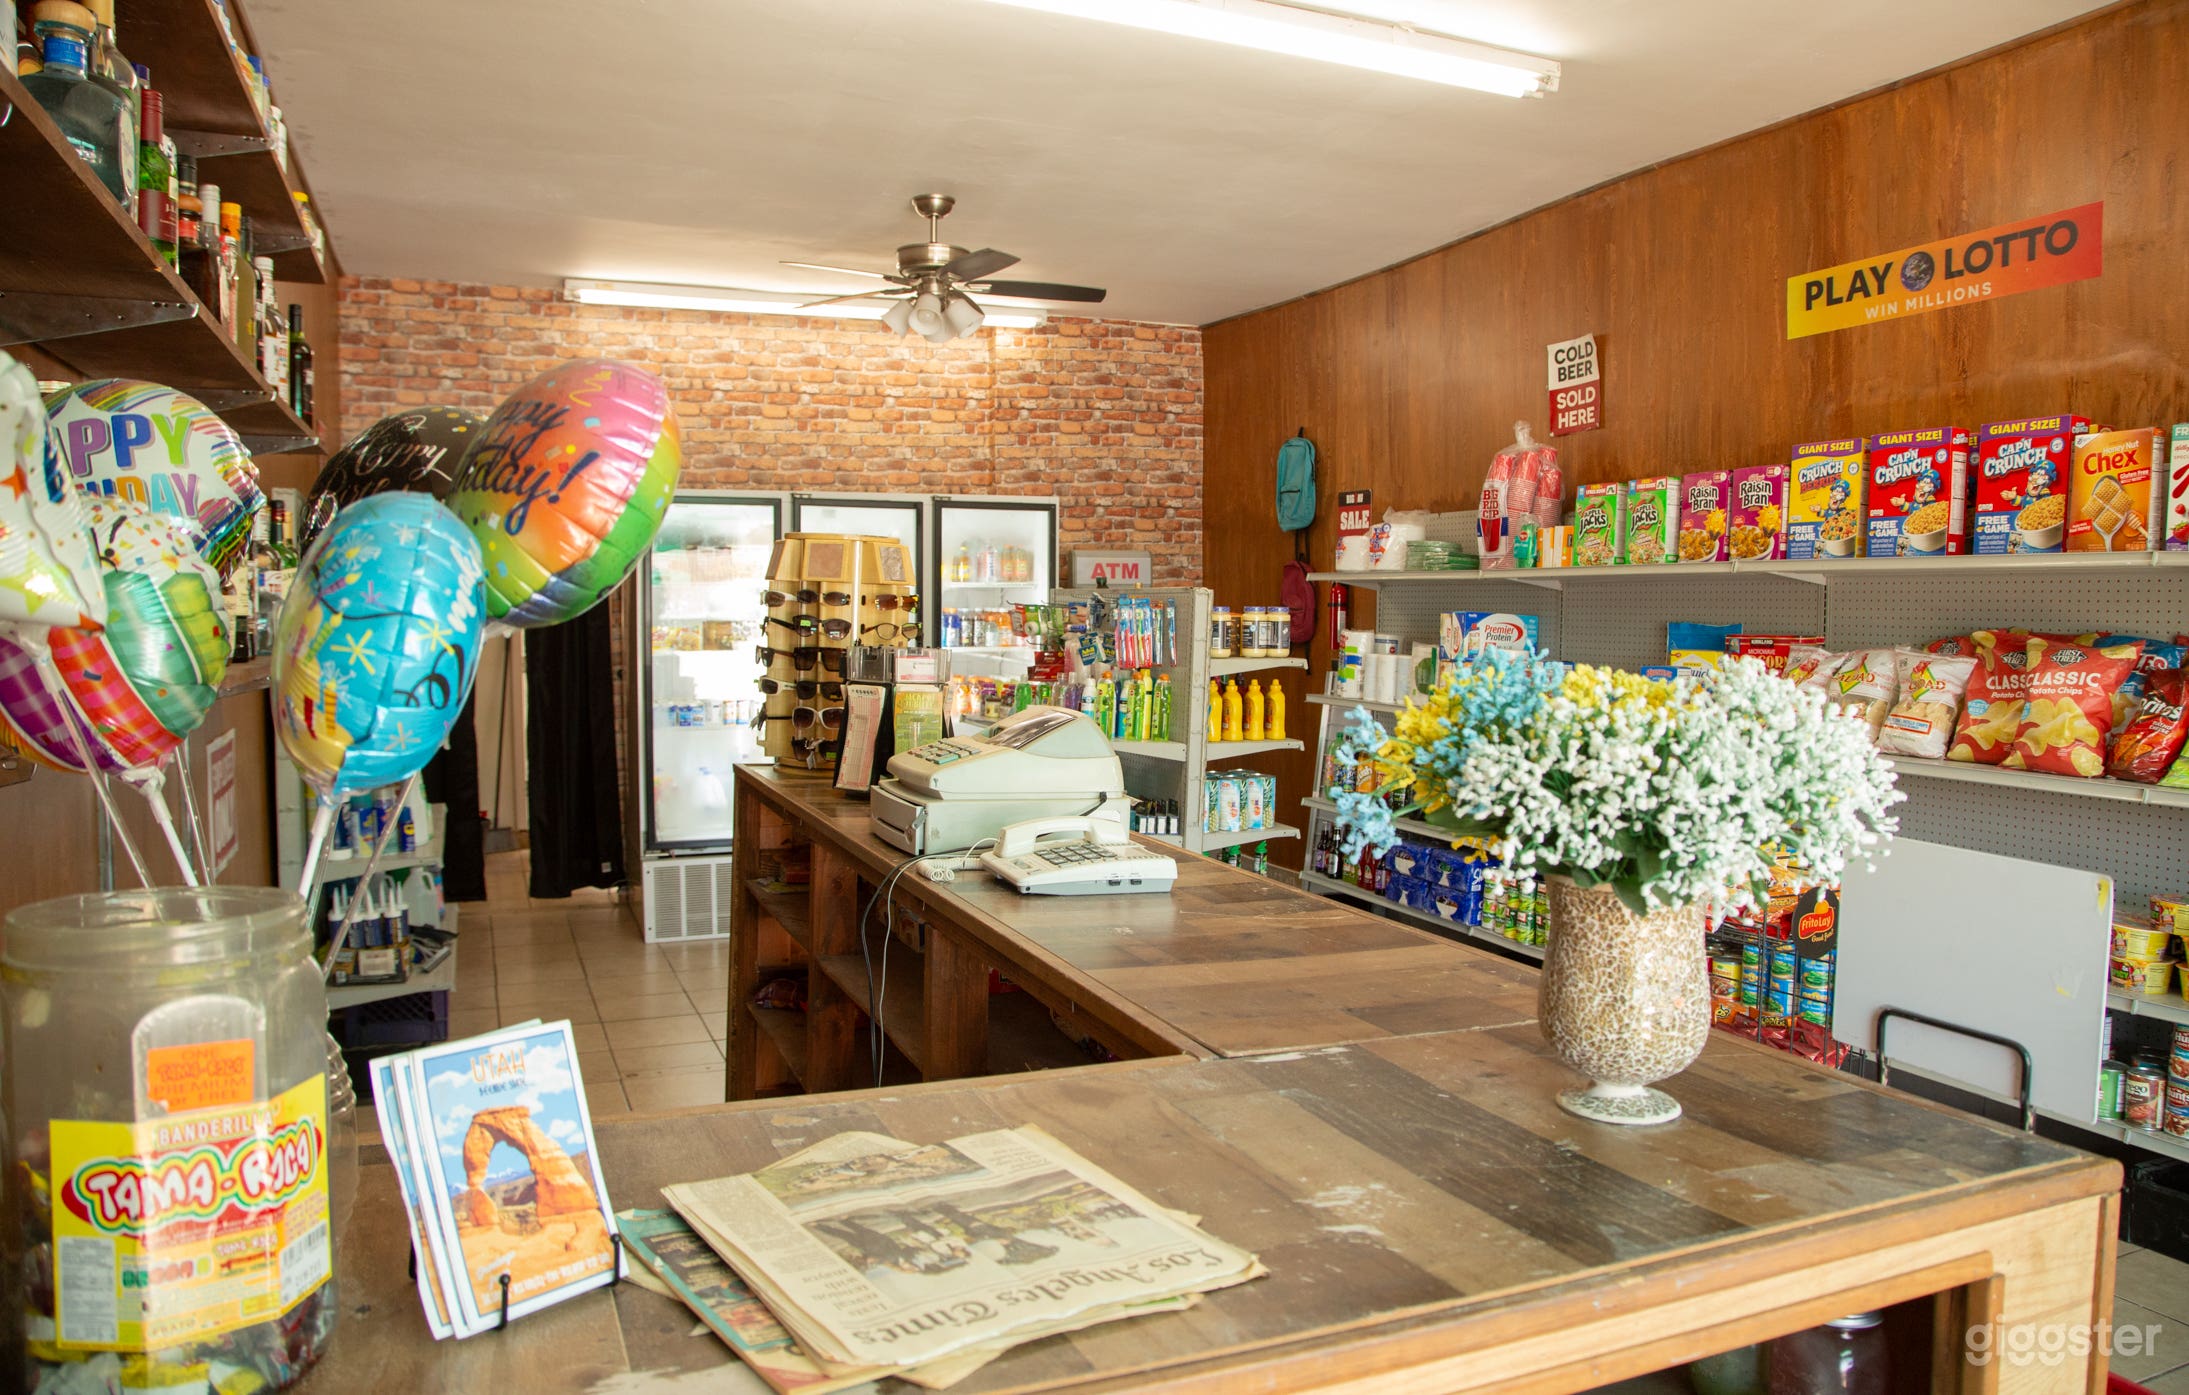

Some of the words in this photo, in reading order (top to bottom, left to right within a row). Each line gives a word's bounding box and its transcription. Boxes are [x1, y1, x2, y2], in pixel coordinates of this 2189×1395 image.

[1805, 262, 1893, 311] PLAY
[1944, 219, 2079, 280] LOTTO
[1865, 302, 1898, 320] WIN
[1906, 282, 1992, 311] MILLIONS
[1554, 341, 1594, 365] COLD
[1557, 360, 1593, 382] BEER
[1556, 386, 1596, 409] SOLD
[1558, 406, 1595, 429] HERE
[1990, 422, 2027, 435] GIANT
[2030, 418, 2061, 431] SIZE!
[2175, 427, 2189, 437] FR
[57, 413, 195, 478] PPY
[1879, 433, 1914, 445] GIANT
[1916, 430, 1942, 442] SIZE!
[2125, 440, 2139, 449] Nut
[1798, 444, 1829, 455] GIANT
[1830, 440, 1854, 452] SIZE!
[1998, 438, 2033, 458] CAP'N
[1888, 448, 1920, 466] CAP'N
[1984, 447, 2048, 478] CRUNCH
[2083, 450, 2139, 475] Chex
[1799, 460, 1844, 483] CRUNCH
[1875, 457, 1933, 484] CRUNCH
[1689, 487, 1718, 501] Raisin
[1740, 481, 1772, 496] Raisin
[1692, 498, 1715, 512] Bran
[1743, 493, 1768, 508] Bran
[1340, 510, 1369, 531] SALE
[1482, 509, 1499, 518] CP
[1979, 515, 2010, 526] FREE
[1579, 514, 1607, 539] JACKS
[1630, 510, 1657, 536] JACKS
[1790, 525, 1815, 534] FREE
[1870, 520, 1899, 529] FREE
[1984, 524, 2011, 534] GAME
[1795, 533, 1816, 541] GAME
[1875, 528, 1899, 537] GAME
[1091, 562, 1139, 579] ATM
[1484, 624, 1515, 635] Premier
[1486, 633, 1512, 642] Protein
[2051, 655, 2085, 664] STREET
[2059, 649, 2083, 657] FIRST
[1986, 674, 2026, 690] CLASS
[2026, 672, 2101, 688] CLASSIC
[1991, 691, 2015, 699] Potato
[2029, 687, 2056, 696] Potato
[2058, 686, 2083, 696] Chips
[471, 1048, 527, 1083] UTAH
[159, 1112, 274, 1146] BANDERILLA
[1148, 1247, 1223, 1274] Los
[993, 1262, 1147, 1309] Angeles
[851, 1299, 998, 1347] Times
